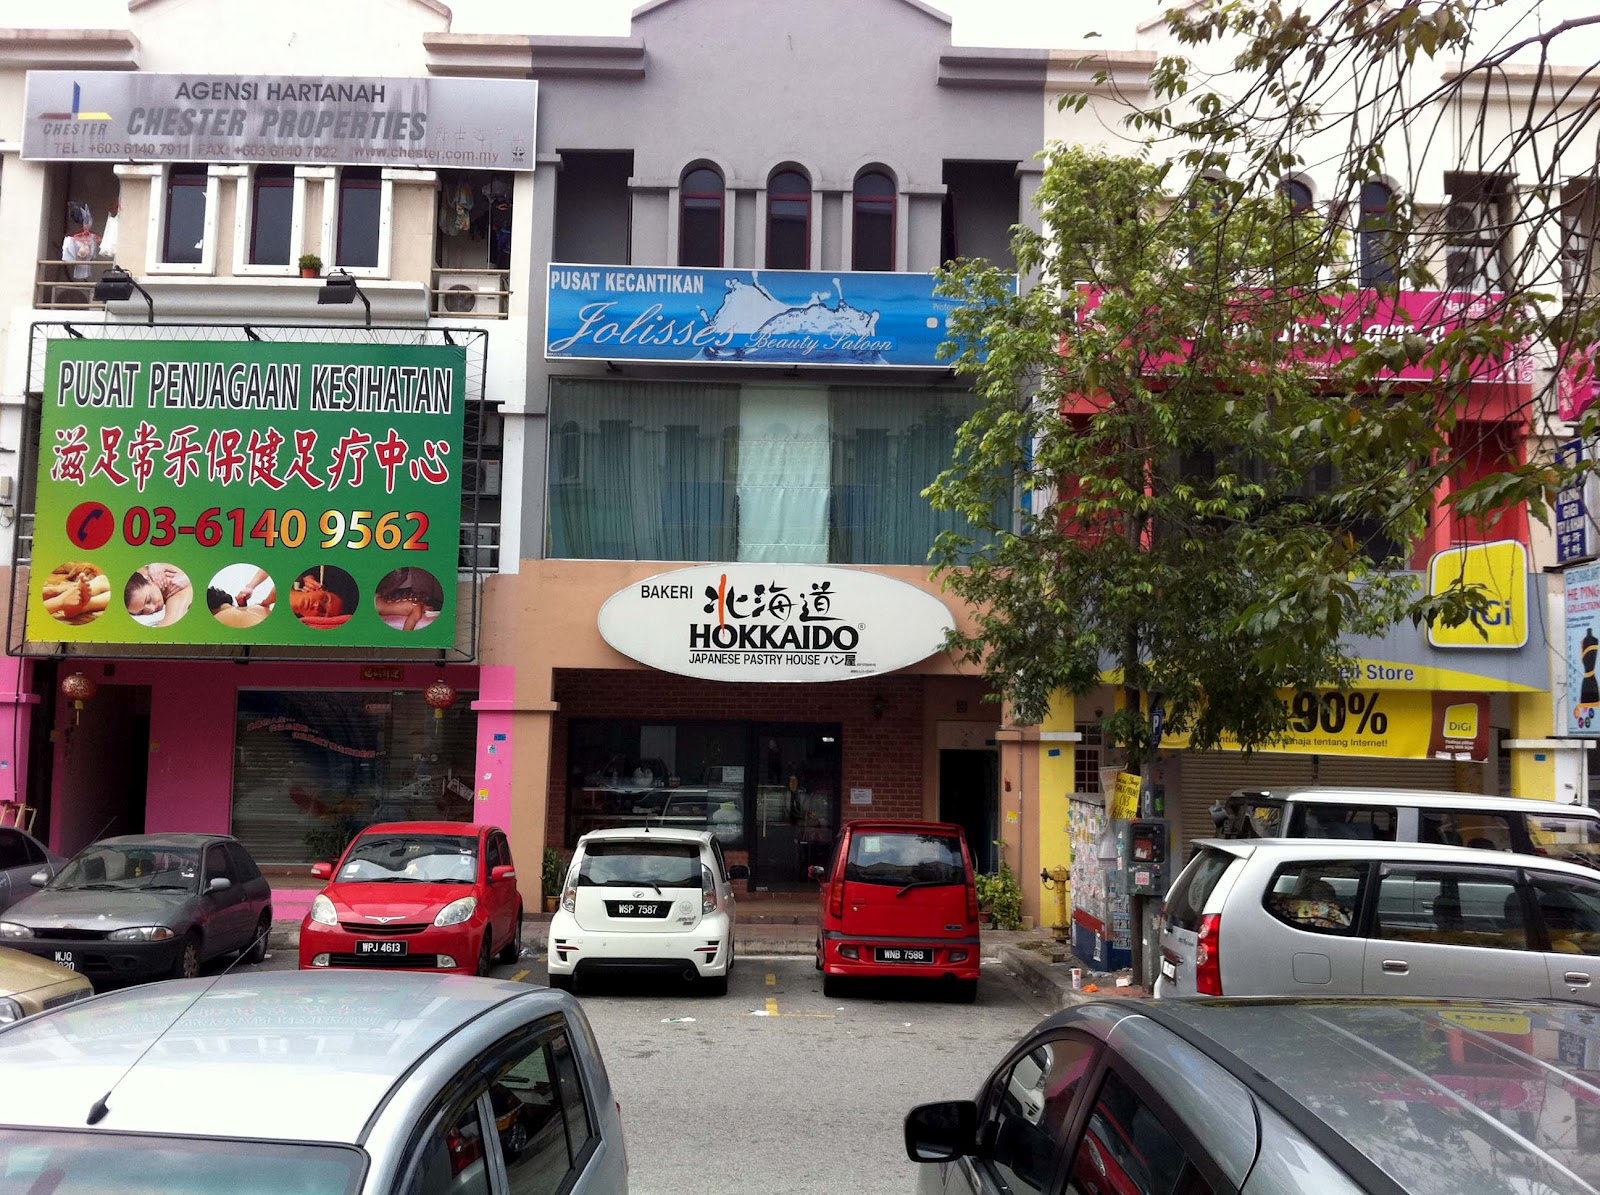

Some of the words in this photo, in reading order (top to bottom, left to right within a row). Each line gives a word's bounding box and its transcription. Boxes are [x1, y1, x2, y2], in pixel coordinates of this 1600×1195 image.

[175, 81, 258, 100] AGENSI
[267, 83, 385, 103] HARTANAH
[43, 122, 107, 135] CHESTER
[127, 107, 247, 137] CHESTER
[259, 109, 427, 141] PROPERTIES
[54, 143, 84, 154] TEL:
[88, 143, 120, 154] +603
[124, 144, 155, 155] 6140
[160, 144, 189, 155] 7911
[198, 144, 230, 156] FAX:
[234, 145, 266, 156] +603
[270, 145, 301, 157] 6140
[306, 145, 338, 158] 7922
[551, 271, 601, 291] PUSAT
[605, 273, 704, 294] KECANTIKAN
[548, 301, 738, 353] Jolisses
[744, 330, 819, 356] Beauty
[823, 331, 893, 351] Saloon
[57, 359, 140, 408] PUSAT
[148, 361, 301, 411] PENJAGAAN
[310, 363, 453, 414] KESIHATAN
[50, 420, 451, 493] 滋足常乐保健足疗中心
[122, 506, 308, 548] 03-6140
[318, 509, 430, 551] 9562
[640, 584, 693, 600] BAKERI
[703, 574, 847, 625] 北海道
[689, 623, 859, 651] HOKKAIDO
[688, 653, 741, 666] JAPANESE
[743, 653, 784, 666] PASTRY
[786, 654, 821, 666] HOUSE
[823, 654, 857, 667] パン屋
[1366, 664, 1415, 681] Store
[1449, 721, 1472, 732] DiGi
[1314, 738, 1348, 748] tentang
[1350, 738, 1388, 748] Internet!
[618, 904, 634, 914] WSP
[638, 904, 658, 915] 7587
[362, 942, 378, 952] WPJ
[380, 942, 401, 952] 4613
[884, 949, 901, 959] WNB
[903, 950, 924, 960] 7588
[54, 951, 73, 962] WJQ
